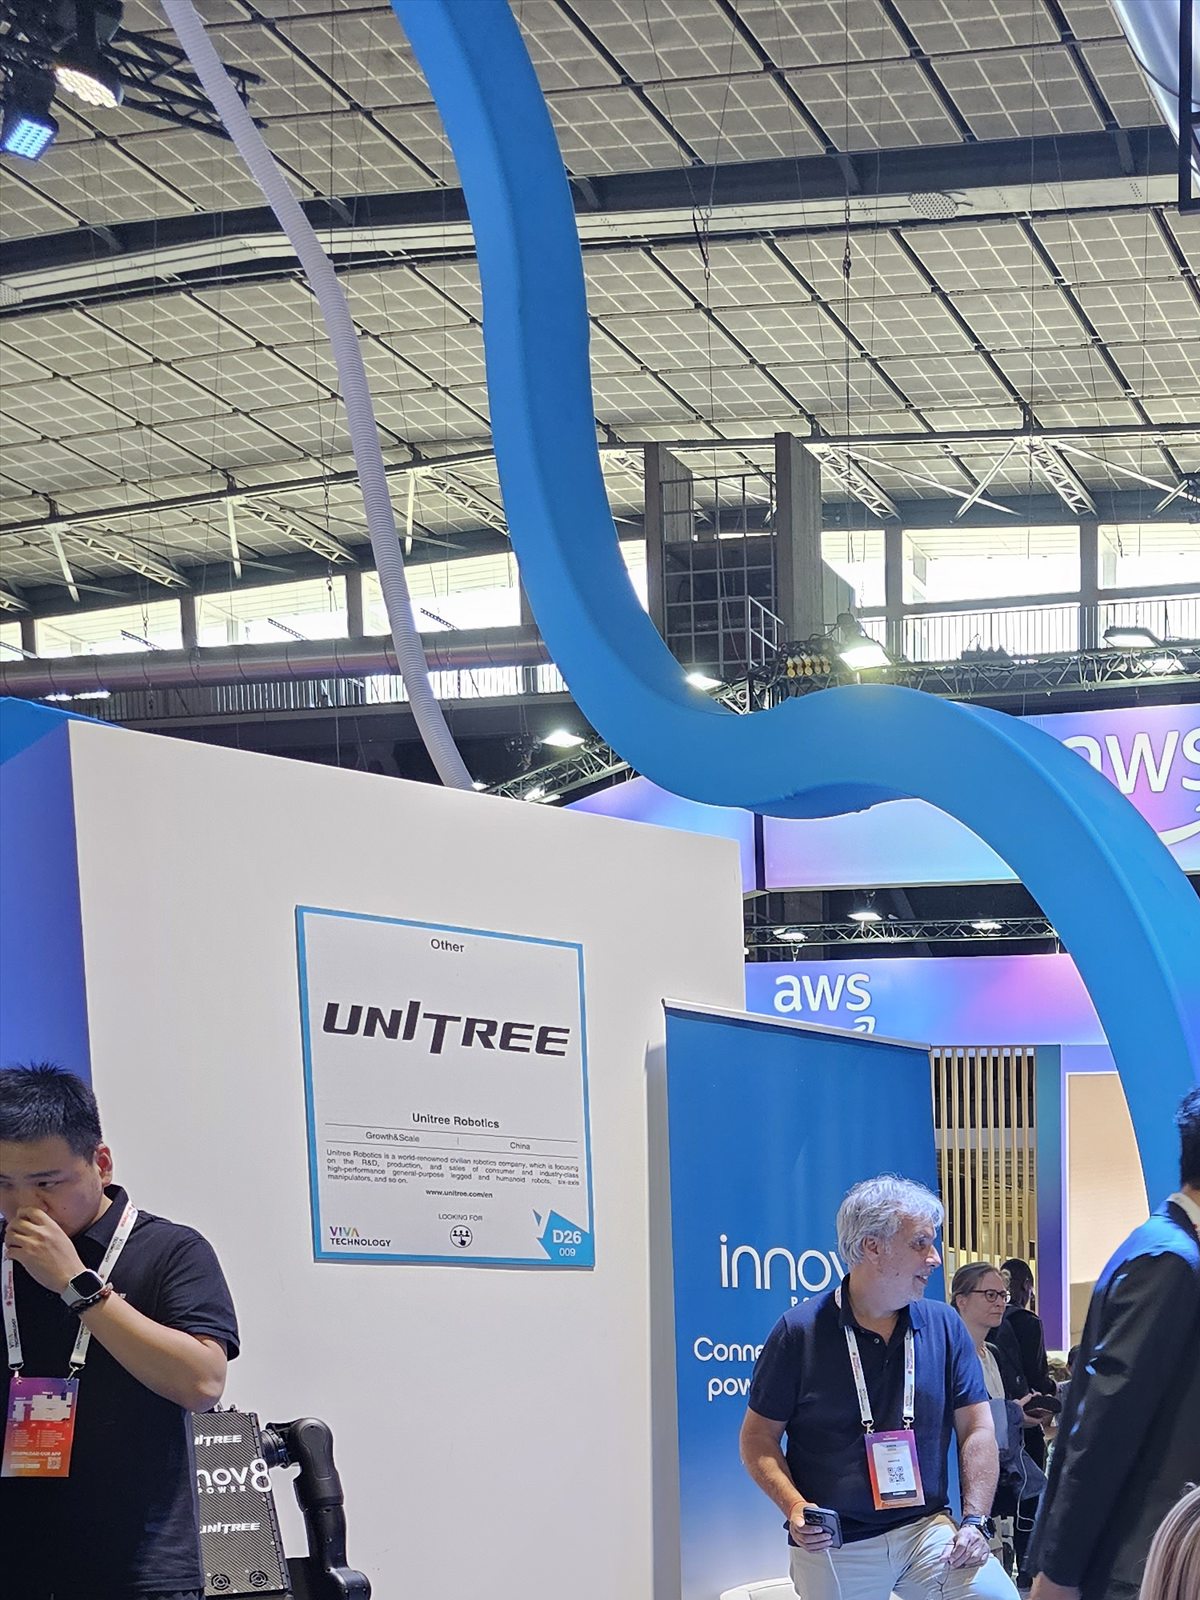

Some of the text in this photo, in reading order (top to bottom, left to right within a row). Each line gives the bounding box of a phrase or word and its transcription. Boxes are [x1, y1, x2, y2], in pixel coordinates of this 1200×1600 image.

[431, 938, 464, 953] Other
[773, 973, 872, 1013] aws
[322, 1000, 570, 1057] UNITREE
[412, 1112, 500, 1129] Unitree Robotics
[365, 1131, 420, 1143] Growth&Scale
[509, 1141, 531, 1150] China
[326, 1149, 351, 1157] Unitree
[353, 1150, 382, 1159] Robotics
[425, 1188, 493, 1199] www.unitree.com/en
[438, 1213, 468, 1221] LOOKING
[329, 1226, 360, 1237] VIVA
[553, 1229, 582, 1245] D26
[329, 1237, 391, 1247] TECHNOLOGY
[559, 1247, 576, 1257] 009
